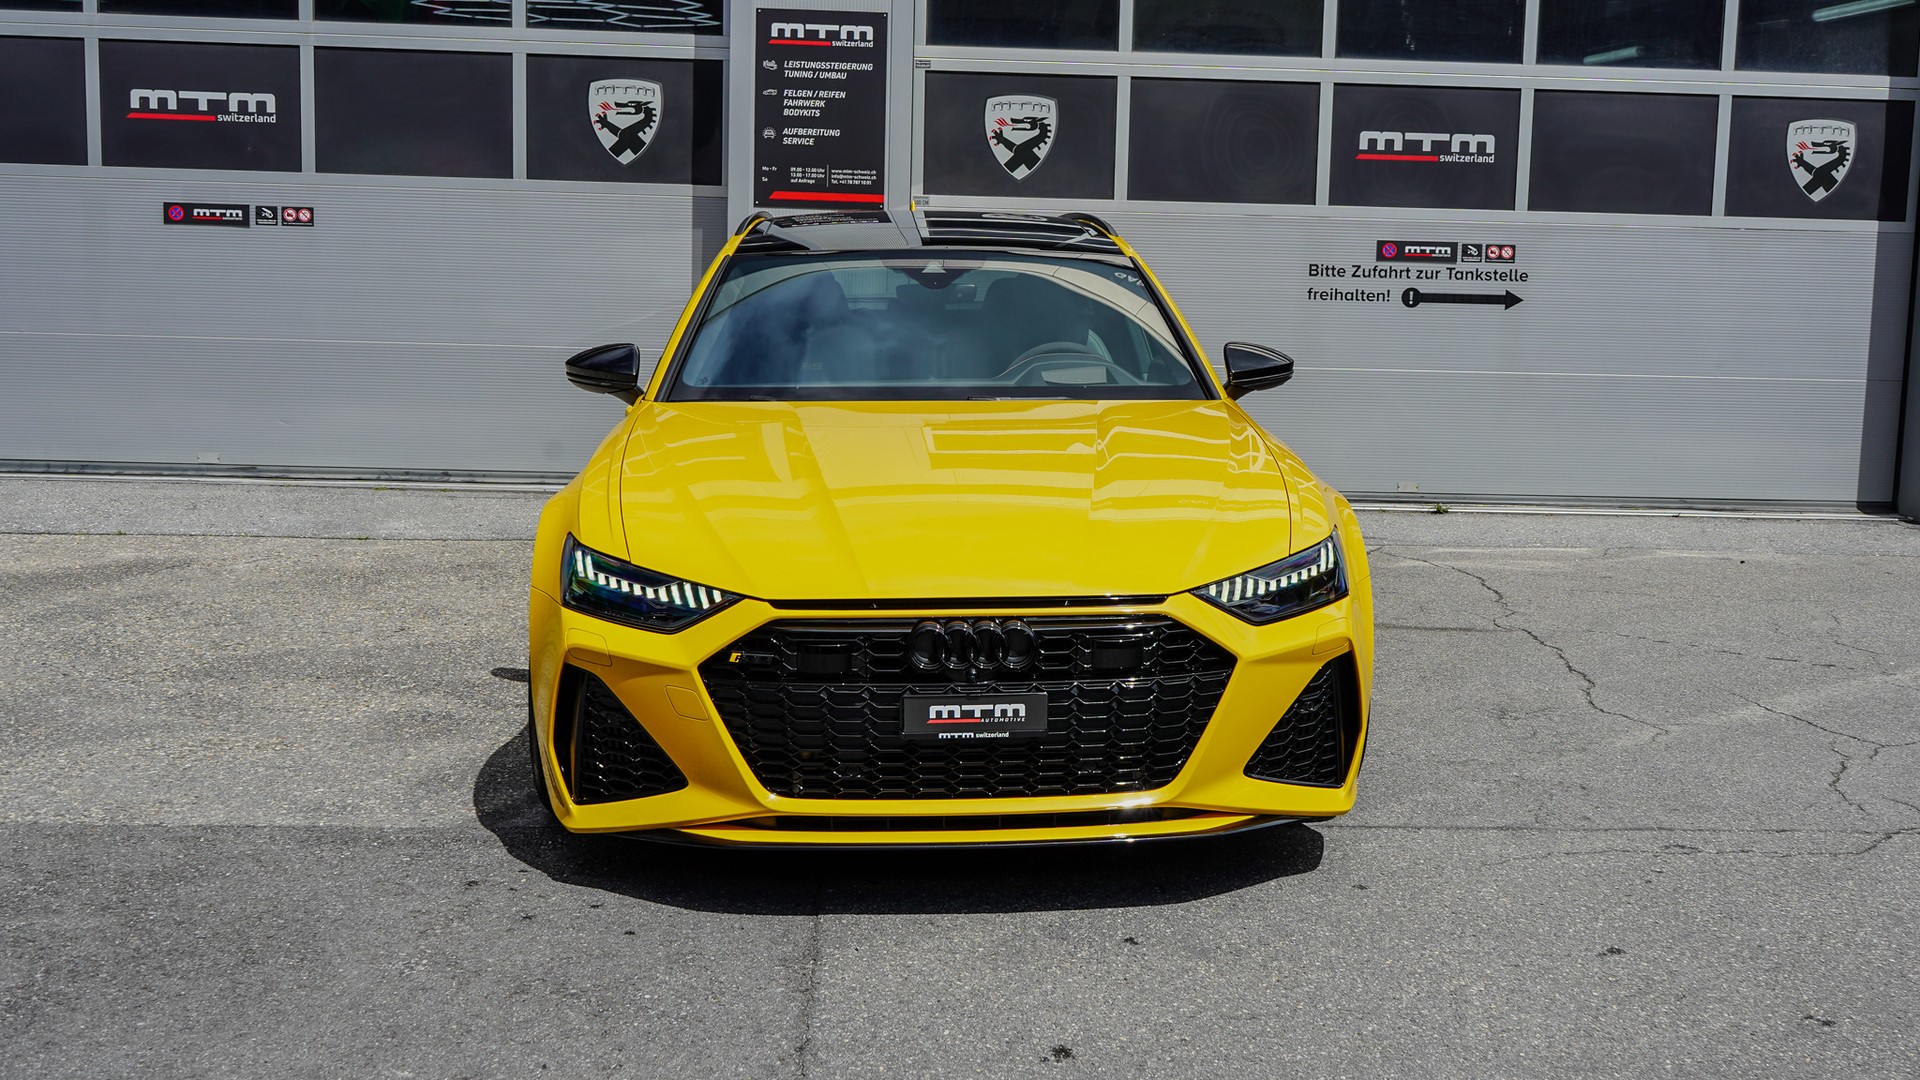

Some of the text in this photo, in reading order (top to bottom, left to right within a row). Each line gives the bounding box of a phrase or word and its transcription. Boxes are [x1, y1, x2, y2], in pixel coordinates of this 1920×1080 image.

[831, 40, 874, 48] switzerland
[784, 60, 873, 71] LEISTUNGSSTEIGERUNG
[784, 70, 814, 79] TUNING
[819, 71, 847, 80] UMBAU
[783, 89, 814, 98] FELGEN
[818, 90, 846, 99] REIFEN
[783, 99, 826, 108] FAHRWERK
[783, 108, 821, 117] BODYKITS
[217, 113, 276, 123] switzerland
[782, 128, 841, 137] AUFBEREITUNG
[782, 137, 815, 146] SERVICE
[1439, 153, 1495, 163] switzerland
[1308, 263, 1529, 283] Bitte Zufahrt zur Tankstelle
[1307, 287, 1391, 302] freihalten!
